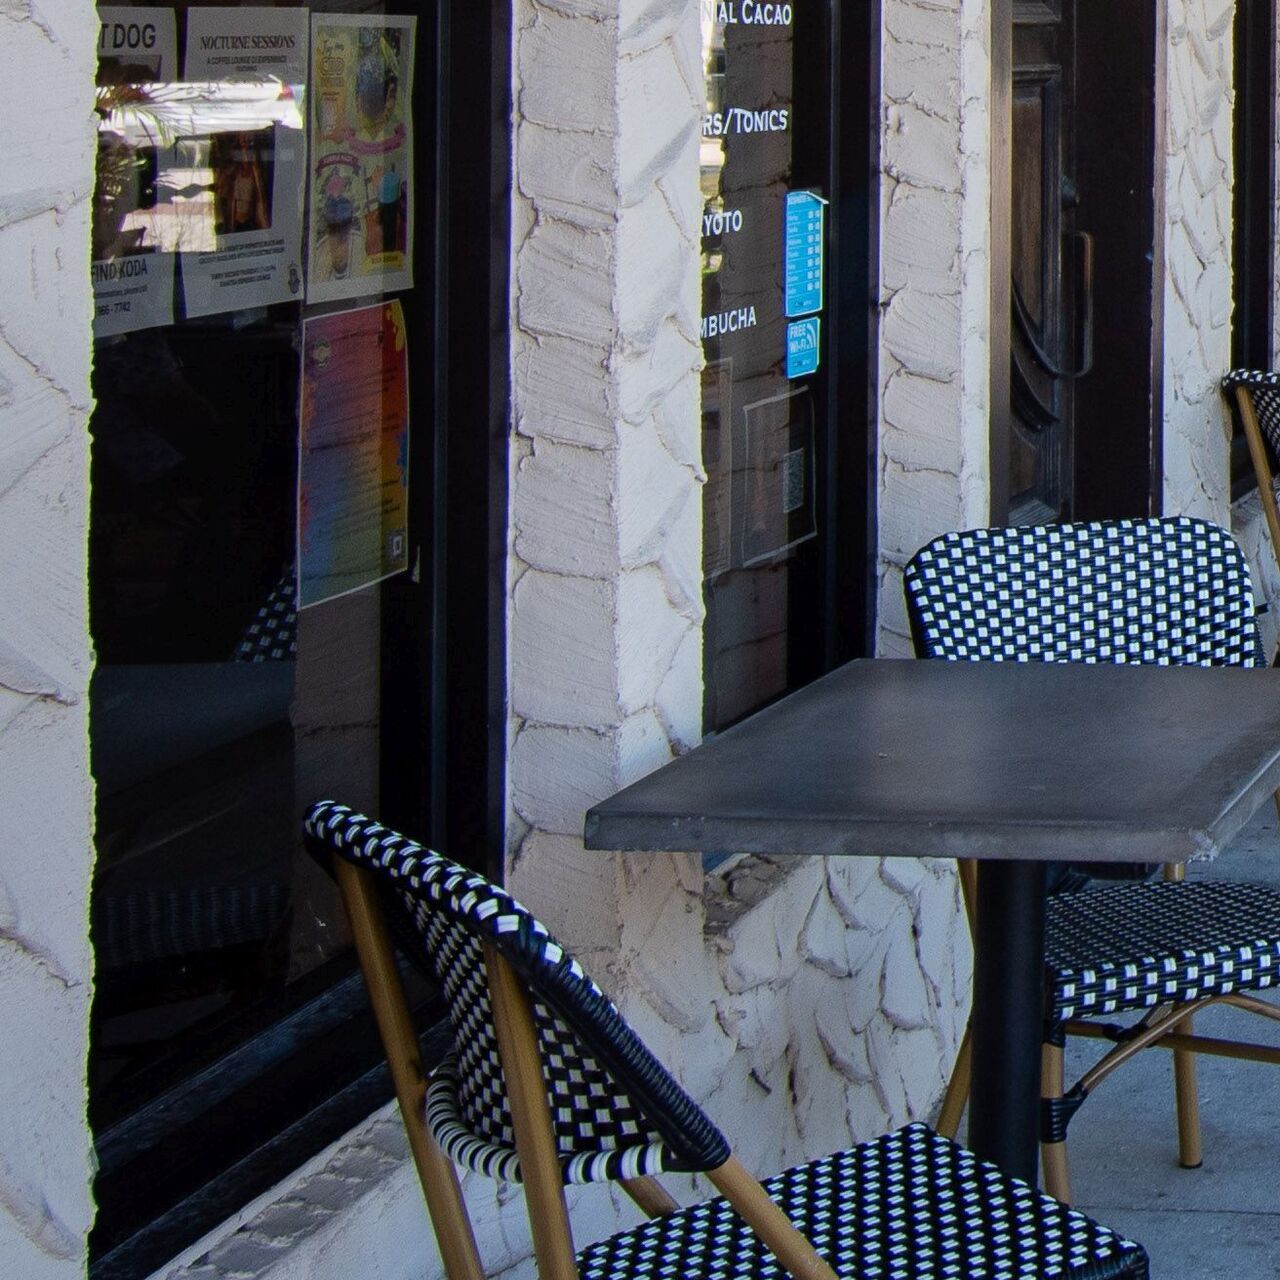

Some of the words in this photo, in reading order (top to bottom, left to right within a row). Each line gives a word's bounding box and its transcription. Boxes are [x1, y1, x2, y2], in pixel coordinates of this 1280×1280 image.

[113, 23, 156, 49] DOG
[252, 34, 295, 50] SESSIONS
[118, 257, 148, 280] KODA
[789, 323, 807, 340] FREE
